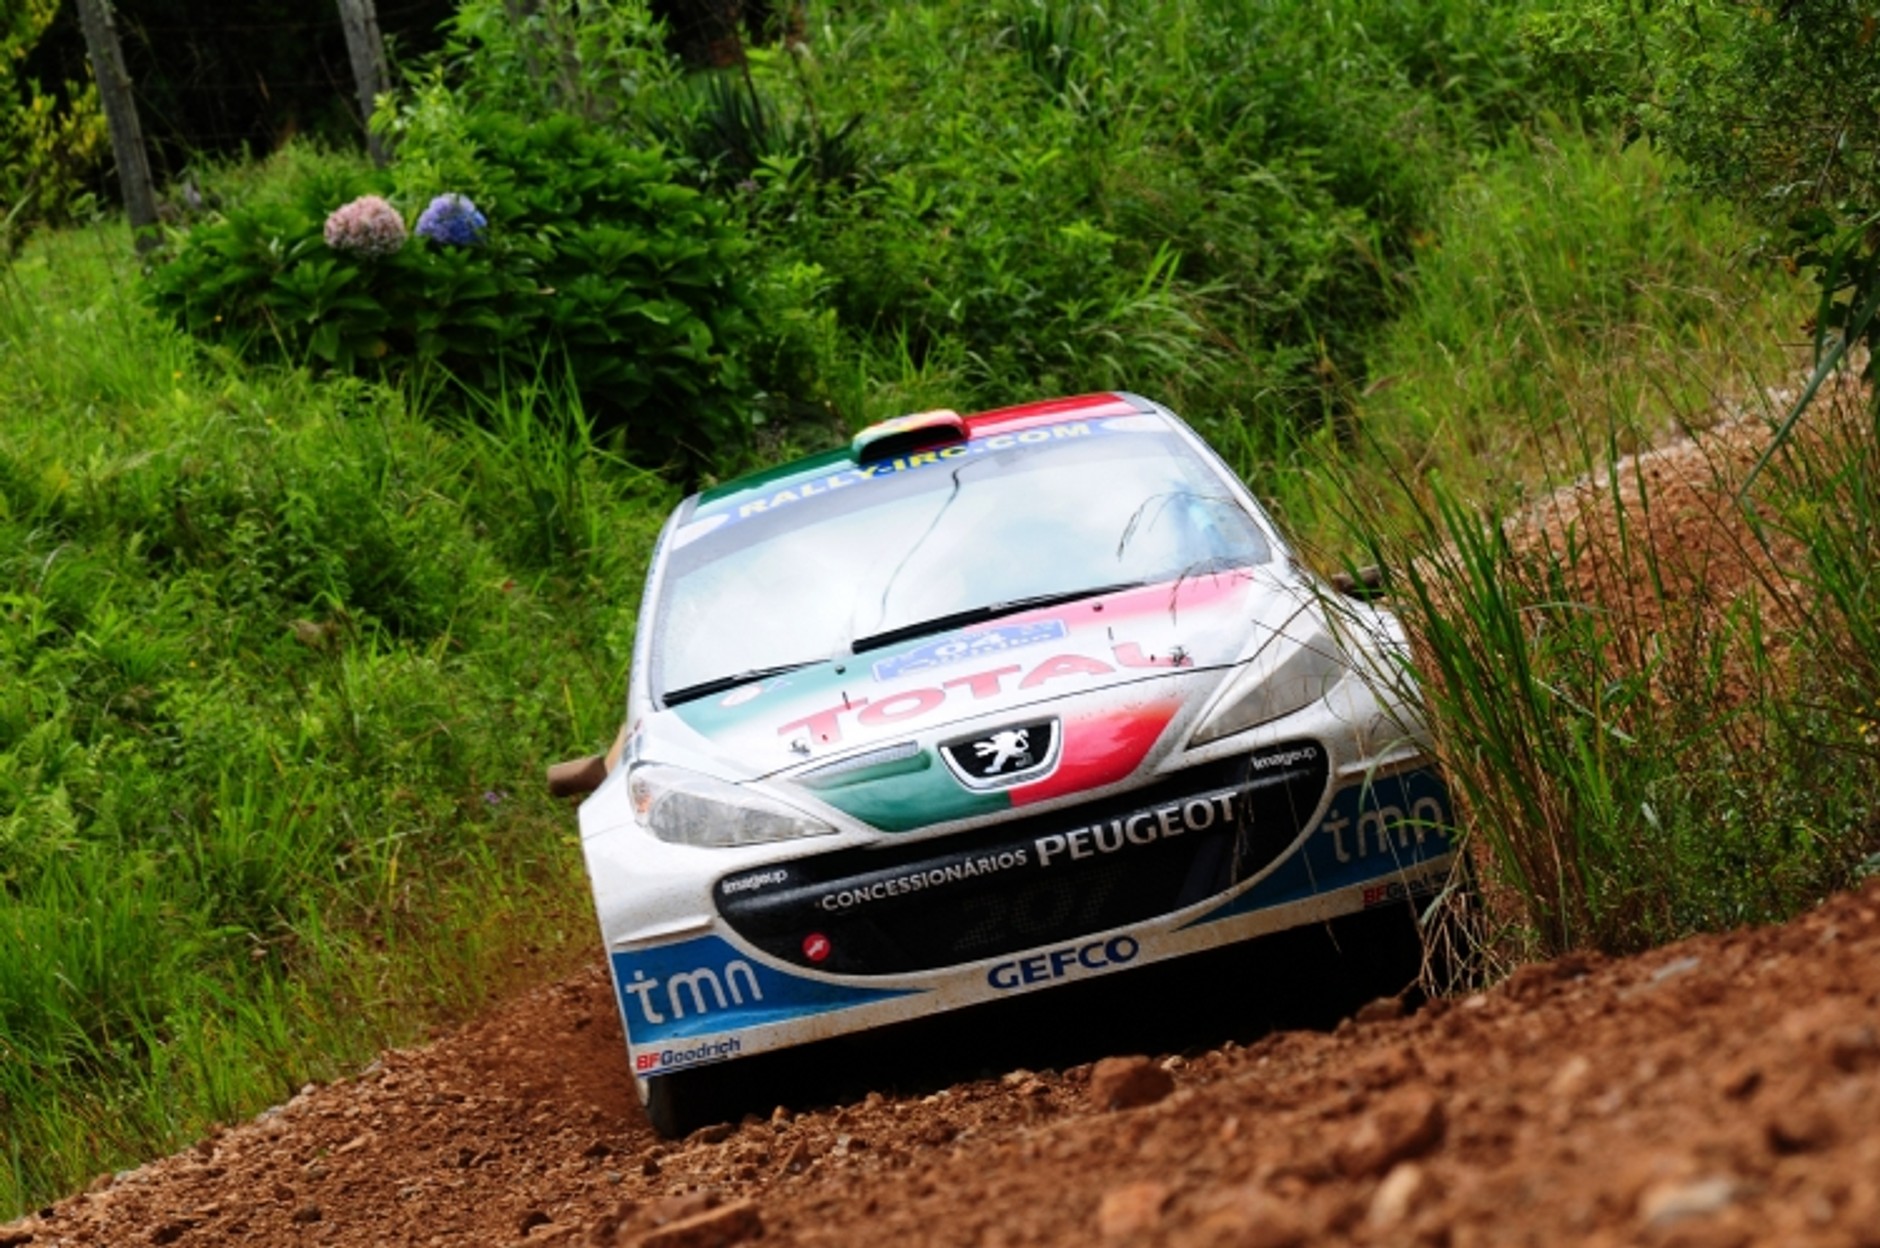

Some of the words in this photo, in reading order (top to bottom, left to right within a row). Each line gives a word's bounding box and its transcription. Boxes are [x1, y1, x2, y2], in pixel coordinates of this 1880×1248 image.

[776, 641, 1194, 747] TOTAL
[820, 848, 1028, 913] CONCESSIONÁRIOS
[1034, 791, 1239, 869] PEUGEOT
[1321, 796, 1447, 863] tmn
[625, 959, 763, 1024] tmn
[987, 935, 1139, 990] GEFCO
[636, 1037, 742, 1070] BFGoodrich
